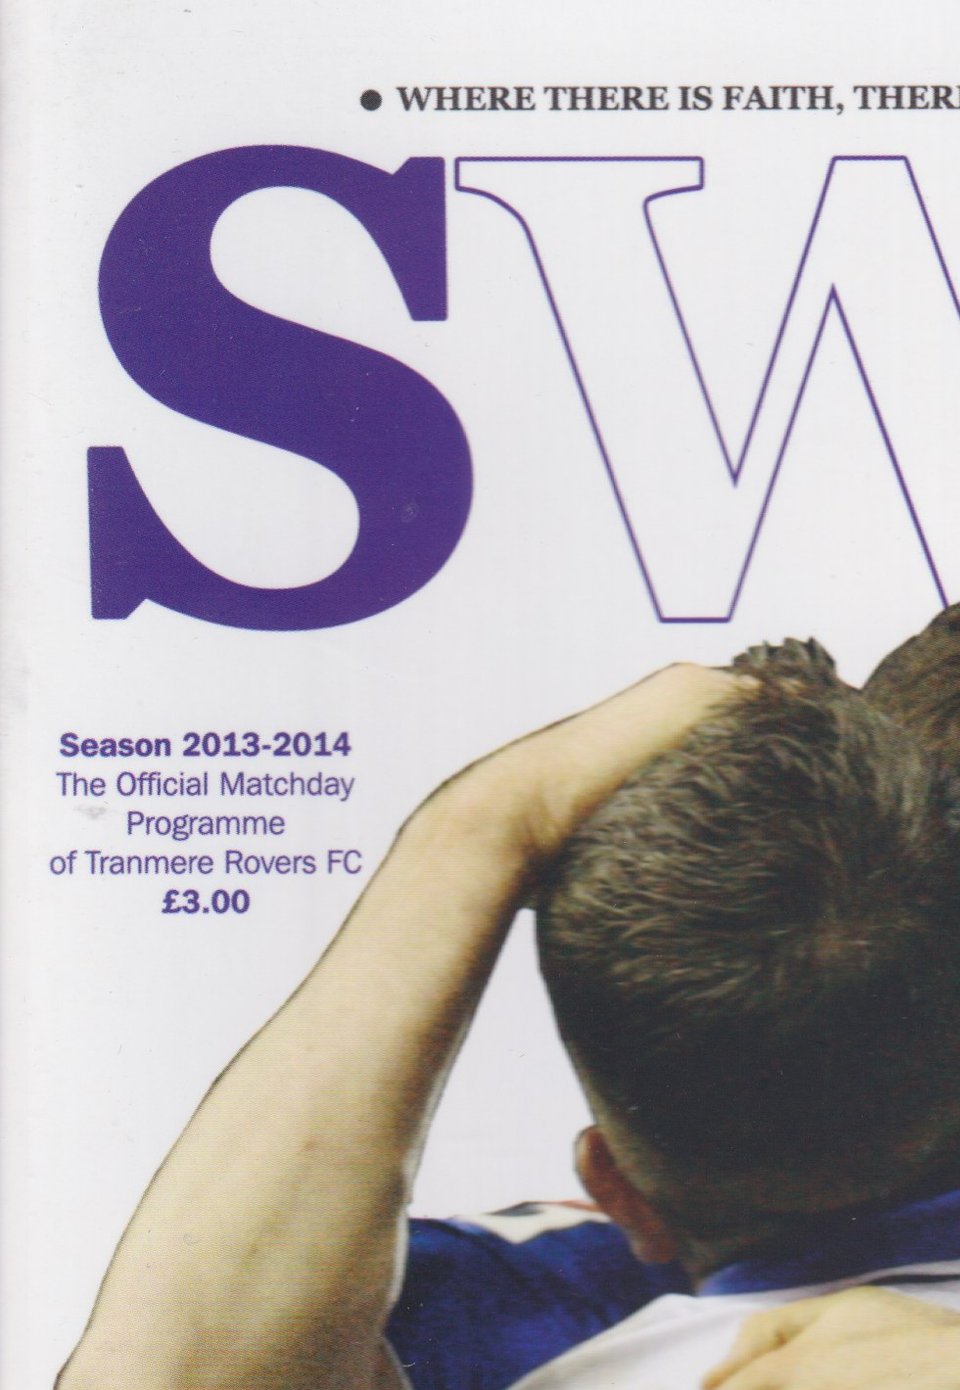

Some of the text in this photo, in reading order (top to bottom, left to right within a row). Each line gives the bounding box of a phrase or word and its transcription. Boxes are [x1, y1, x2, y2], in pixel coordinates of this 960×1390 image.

[396, 86, 536, 111] WHERE
[544, 86, 669, 111] THERE
[678, 86, 713, 111] IS
[722, 85, 844, 115] FAITH,
[60, 731, 352, 758] Season 2013-2014
[56, 771, 355, 802] The Official Matchday
[127, 811, 285, 841] Programme
[49, 849, 362, 875] of Tranmere Rovers FC
[161, 889, 250, 914] £3.00
